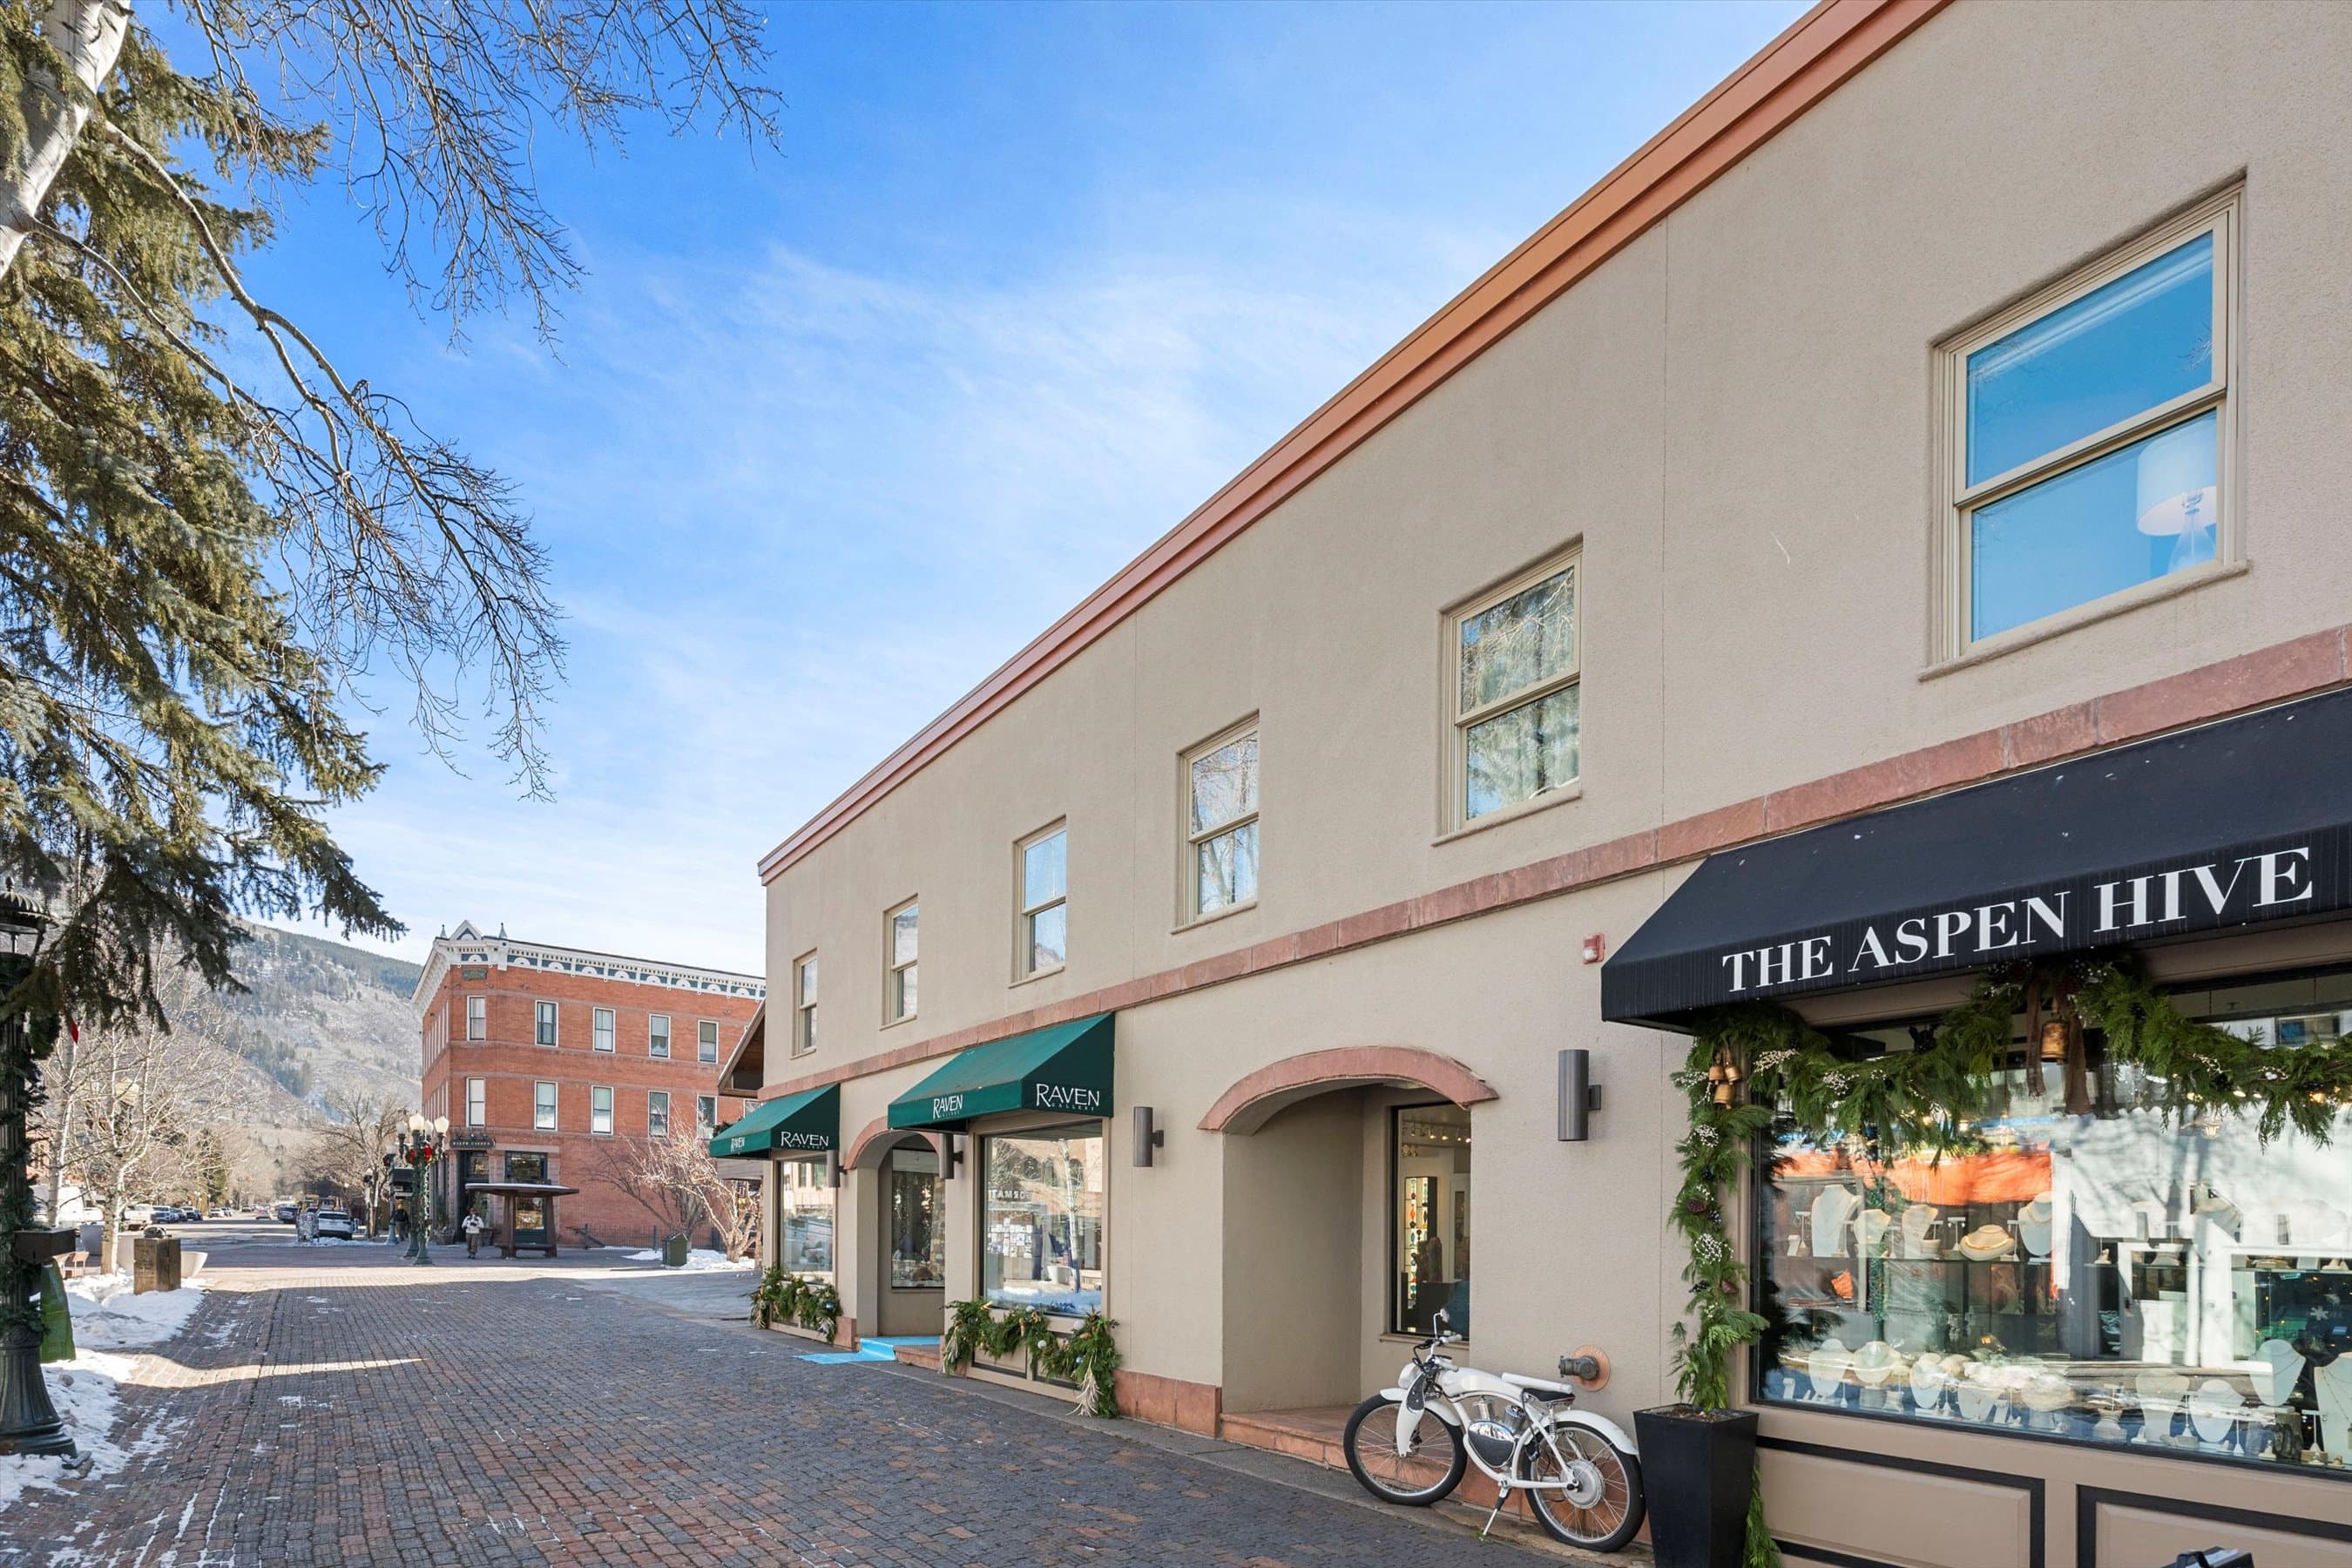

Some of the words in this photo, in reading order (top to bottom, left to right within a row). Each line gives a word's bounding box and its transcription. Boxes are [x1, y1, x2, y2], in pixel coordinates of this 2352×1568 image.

[1722, 936, 1835, 992] THE
[1848, 890, 2072, 972] ASPEN
[2093, 847, 2313, 933] HIVE
[933, 1094, 963, 1119] RAVEN
[1035, 1083, 1100, 1107] RAVEN
[781, 1131, 828, 1147] RAVEN
